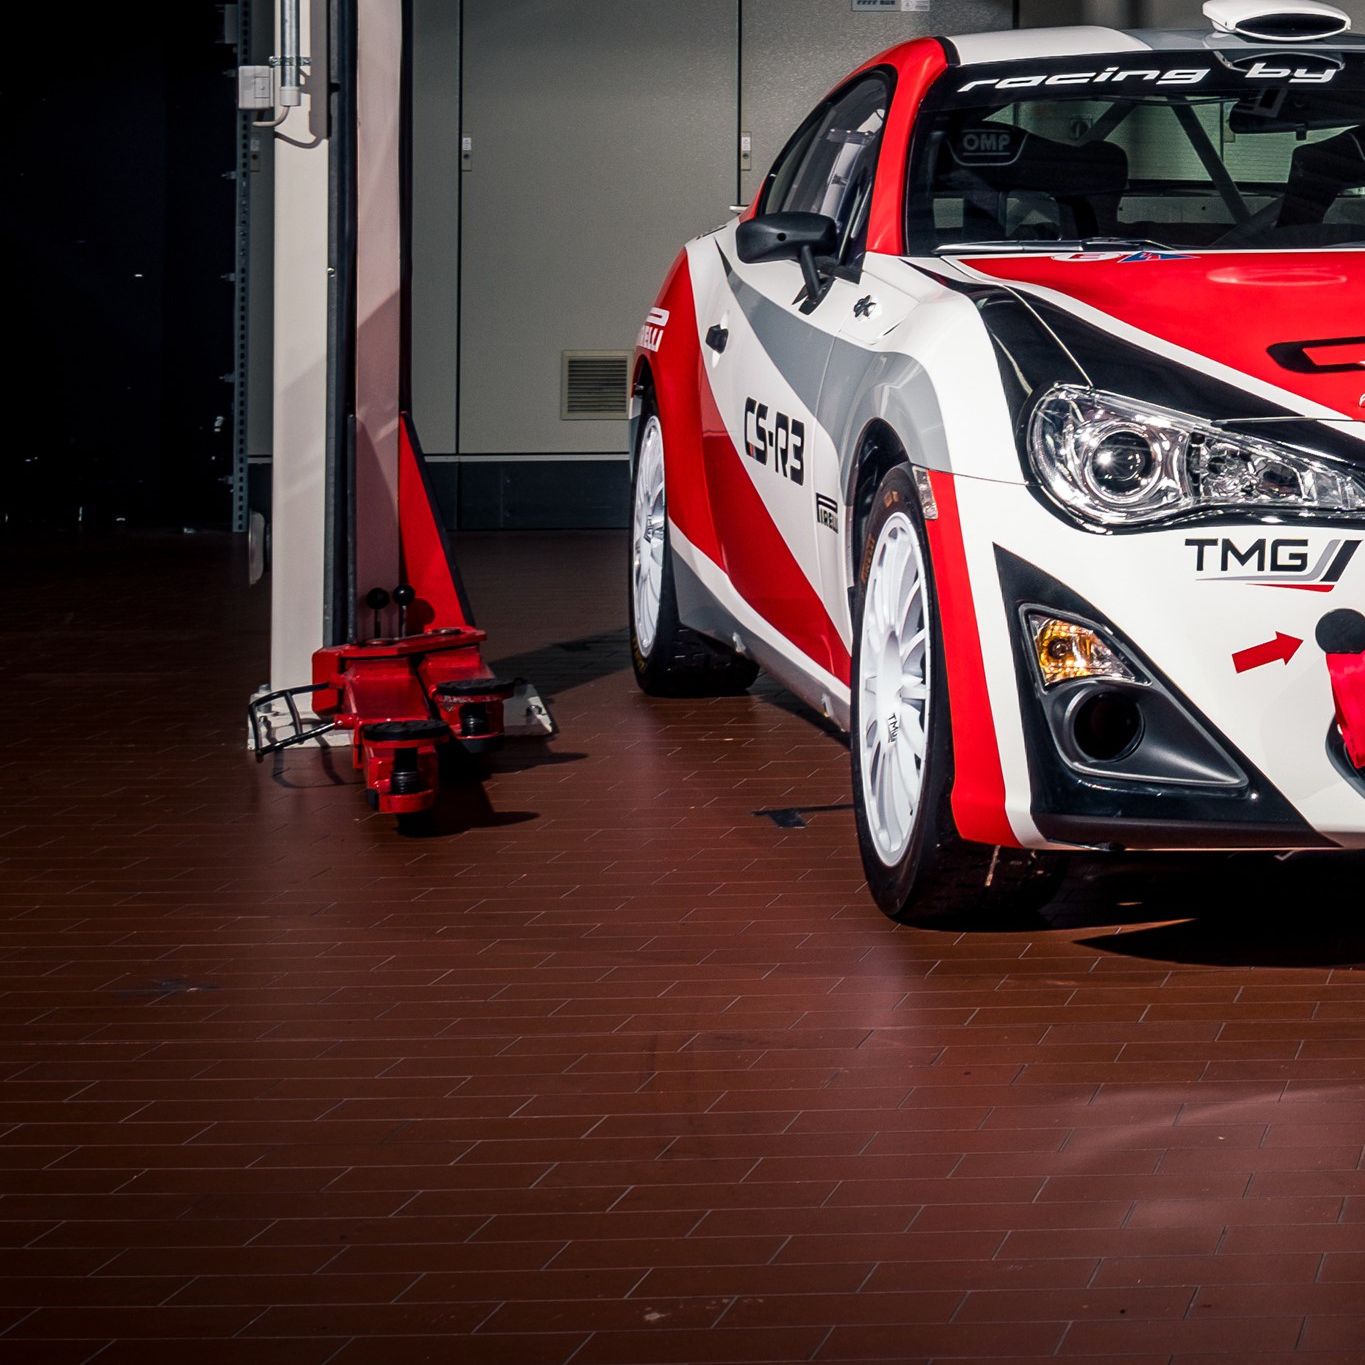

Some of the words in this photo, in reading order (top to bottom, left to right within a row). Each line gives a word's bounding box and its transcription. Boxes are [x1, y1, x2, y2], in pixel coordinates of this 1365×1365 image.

[957, 66, 1211, 93] racing
[1245, 62, 1337, 84] by
[963, 132, 1011, 151] OMP
[744, 396, 806, 486] CS-R3
[1184, 538, 1309, 572] TMG
